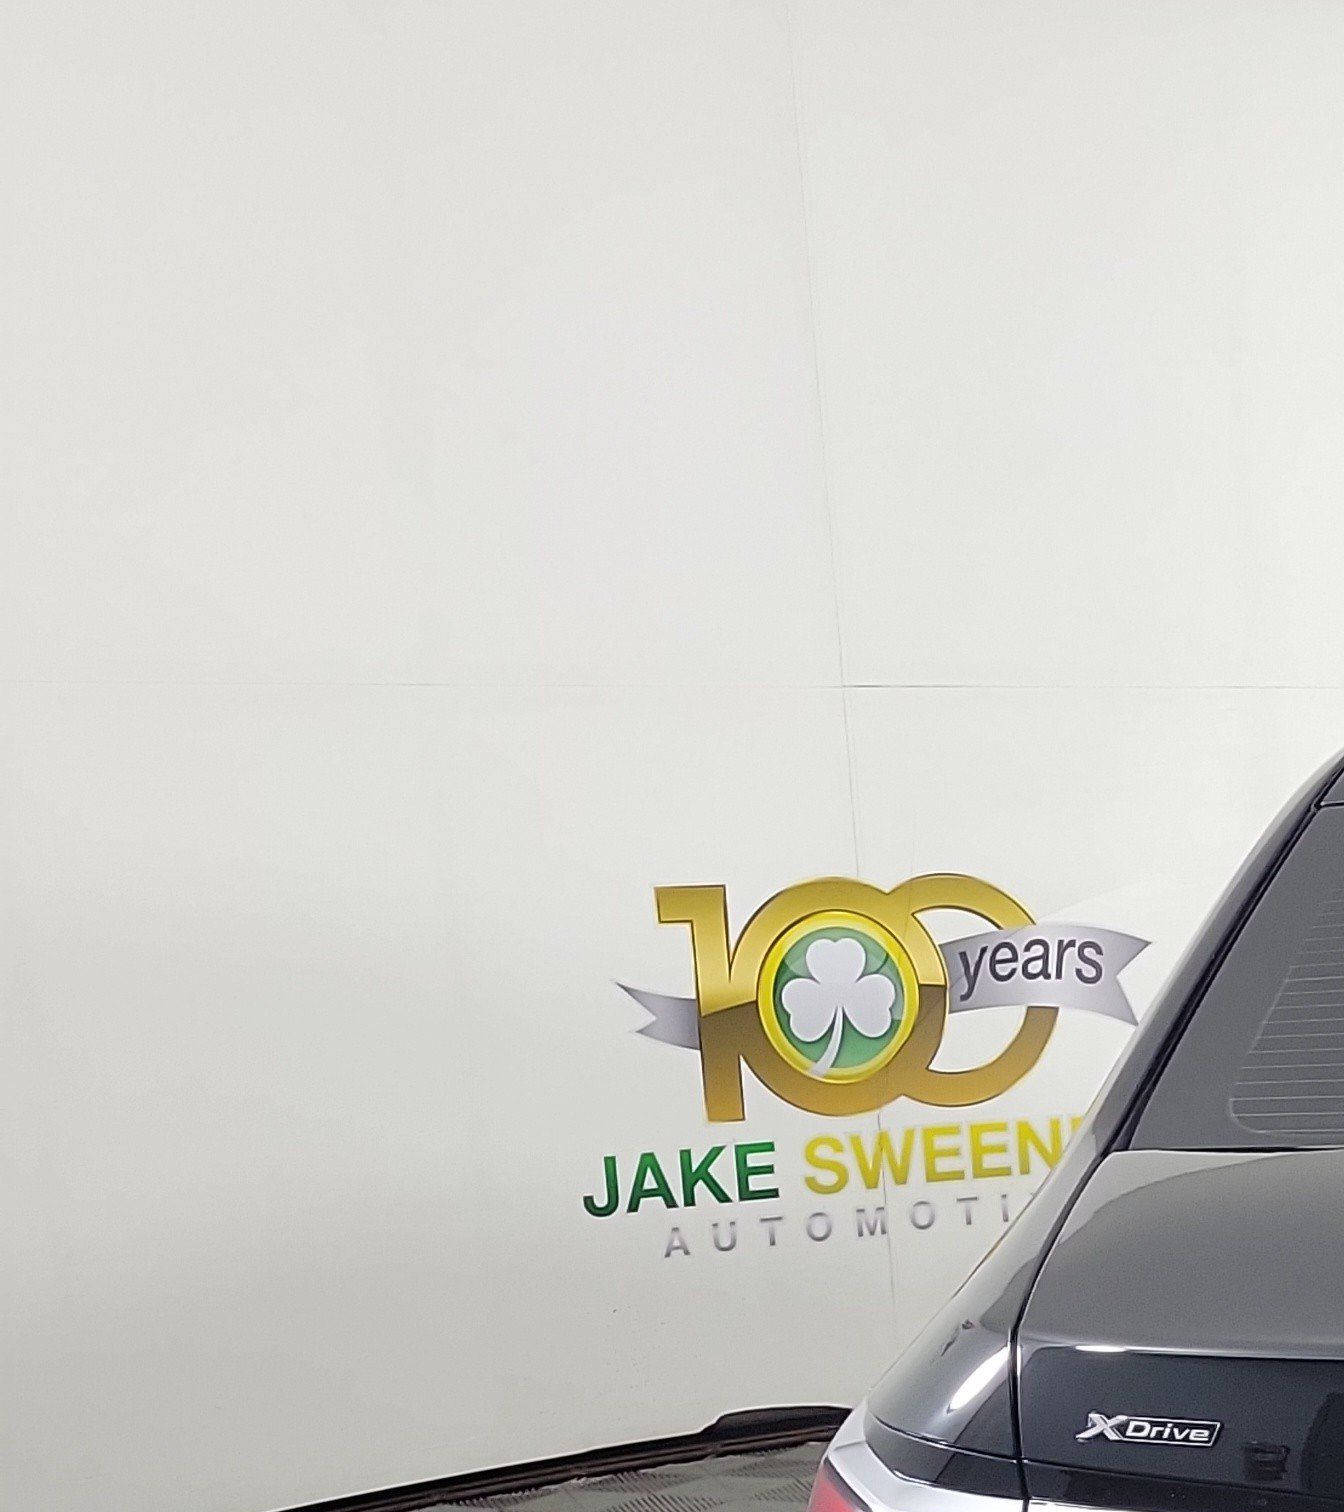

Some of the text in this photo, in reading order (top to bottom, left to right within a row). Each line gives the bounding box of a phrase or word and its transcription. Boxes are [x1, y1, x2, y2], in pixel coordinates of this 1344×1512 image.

[957, 938, 1104, 1001] years
[583, 1115, 1084, 1217] JAKE SWEEN
[664, 1192, 1034, 1258] AUTOMOTI
